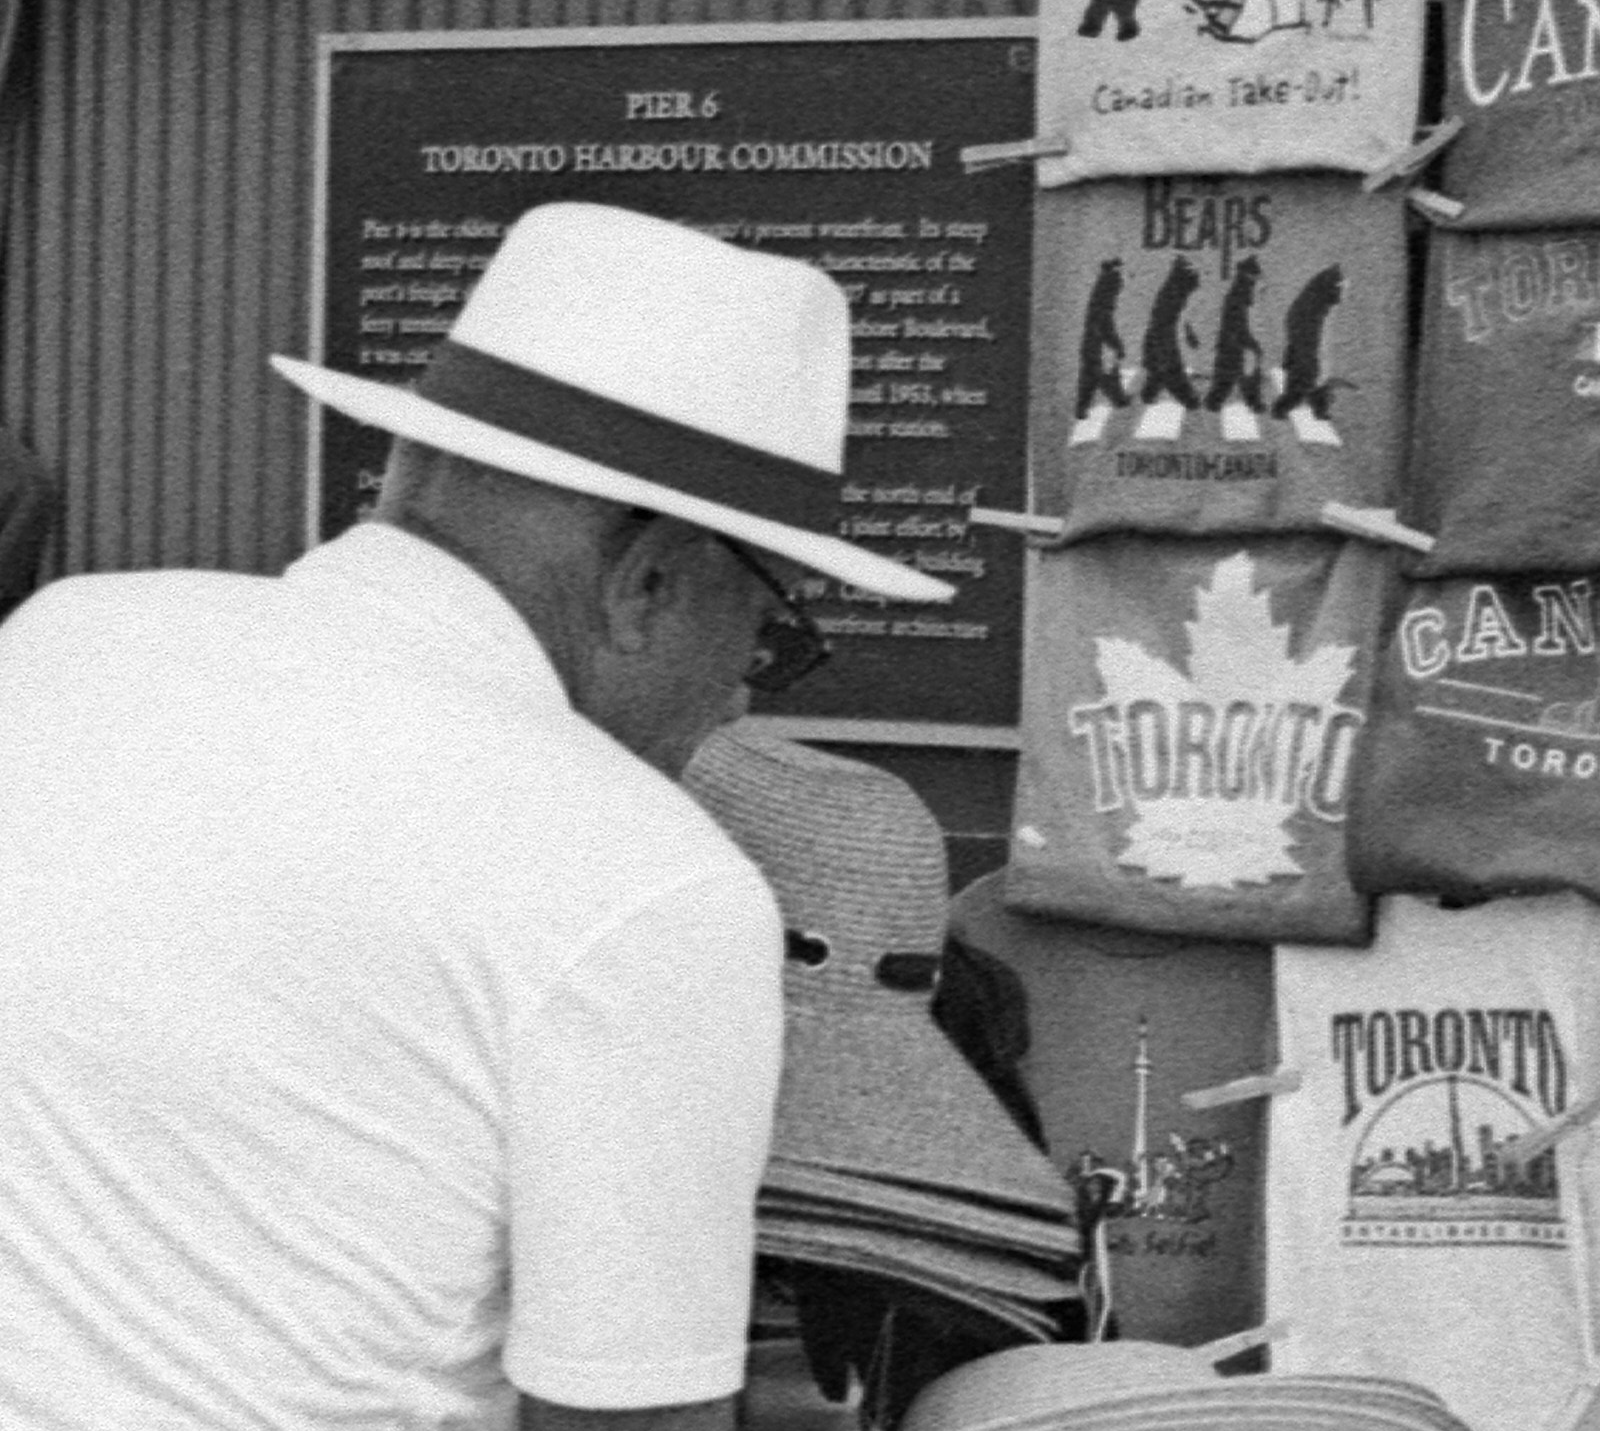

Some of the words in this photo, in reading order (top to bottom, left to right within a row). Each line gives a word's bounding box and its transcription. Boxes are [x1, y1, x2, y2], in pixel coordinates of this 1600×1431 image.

[624, 91, 691, 121] PIER
[702, 91, 721, 118] 6
[1093, 78, 1213, 114] Canadian
[421, 144, 564, 172] TORONTO
[574, 141, 722, 171] HARBOUR
[731, 138, 933, 169] COMMISSION
[1141, 176, 1273, 281] BEARS
[1068, 699, 1367, 819] TORONTO
[1332, 1008, 1568, 1127] TORONTO
